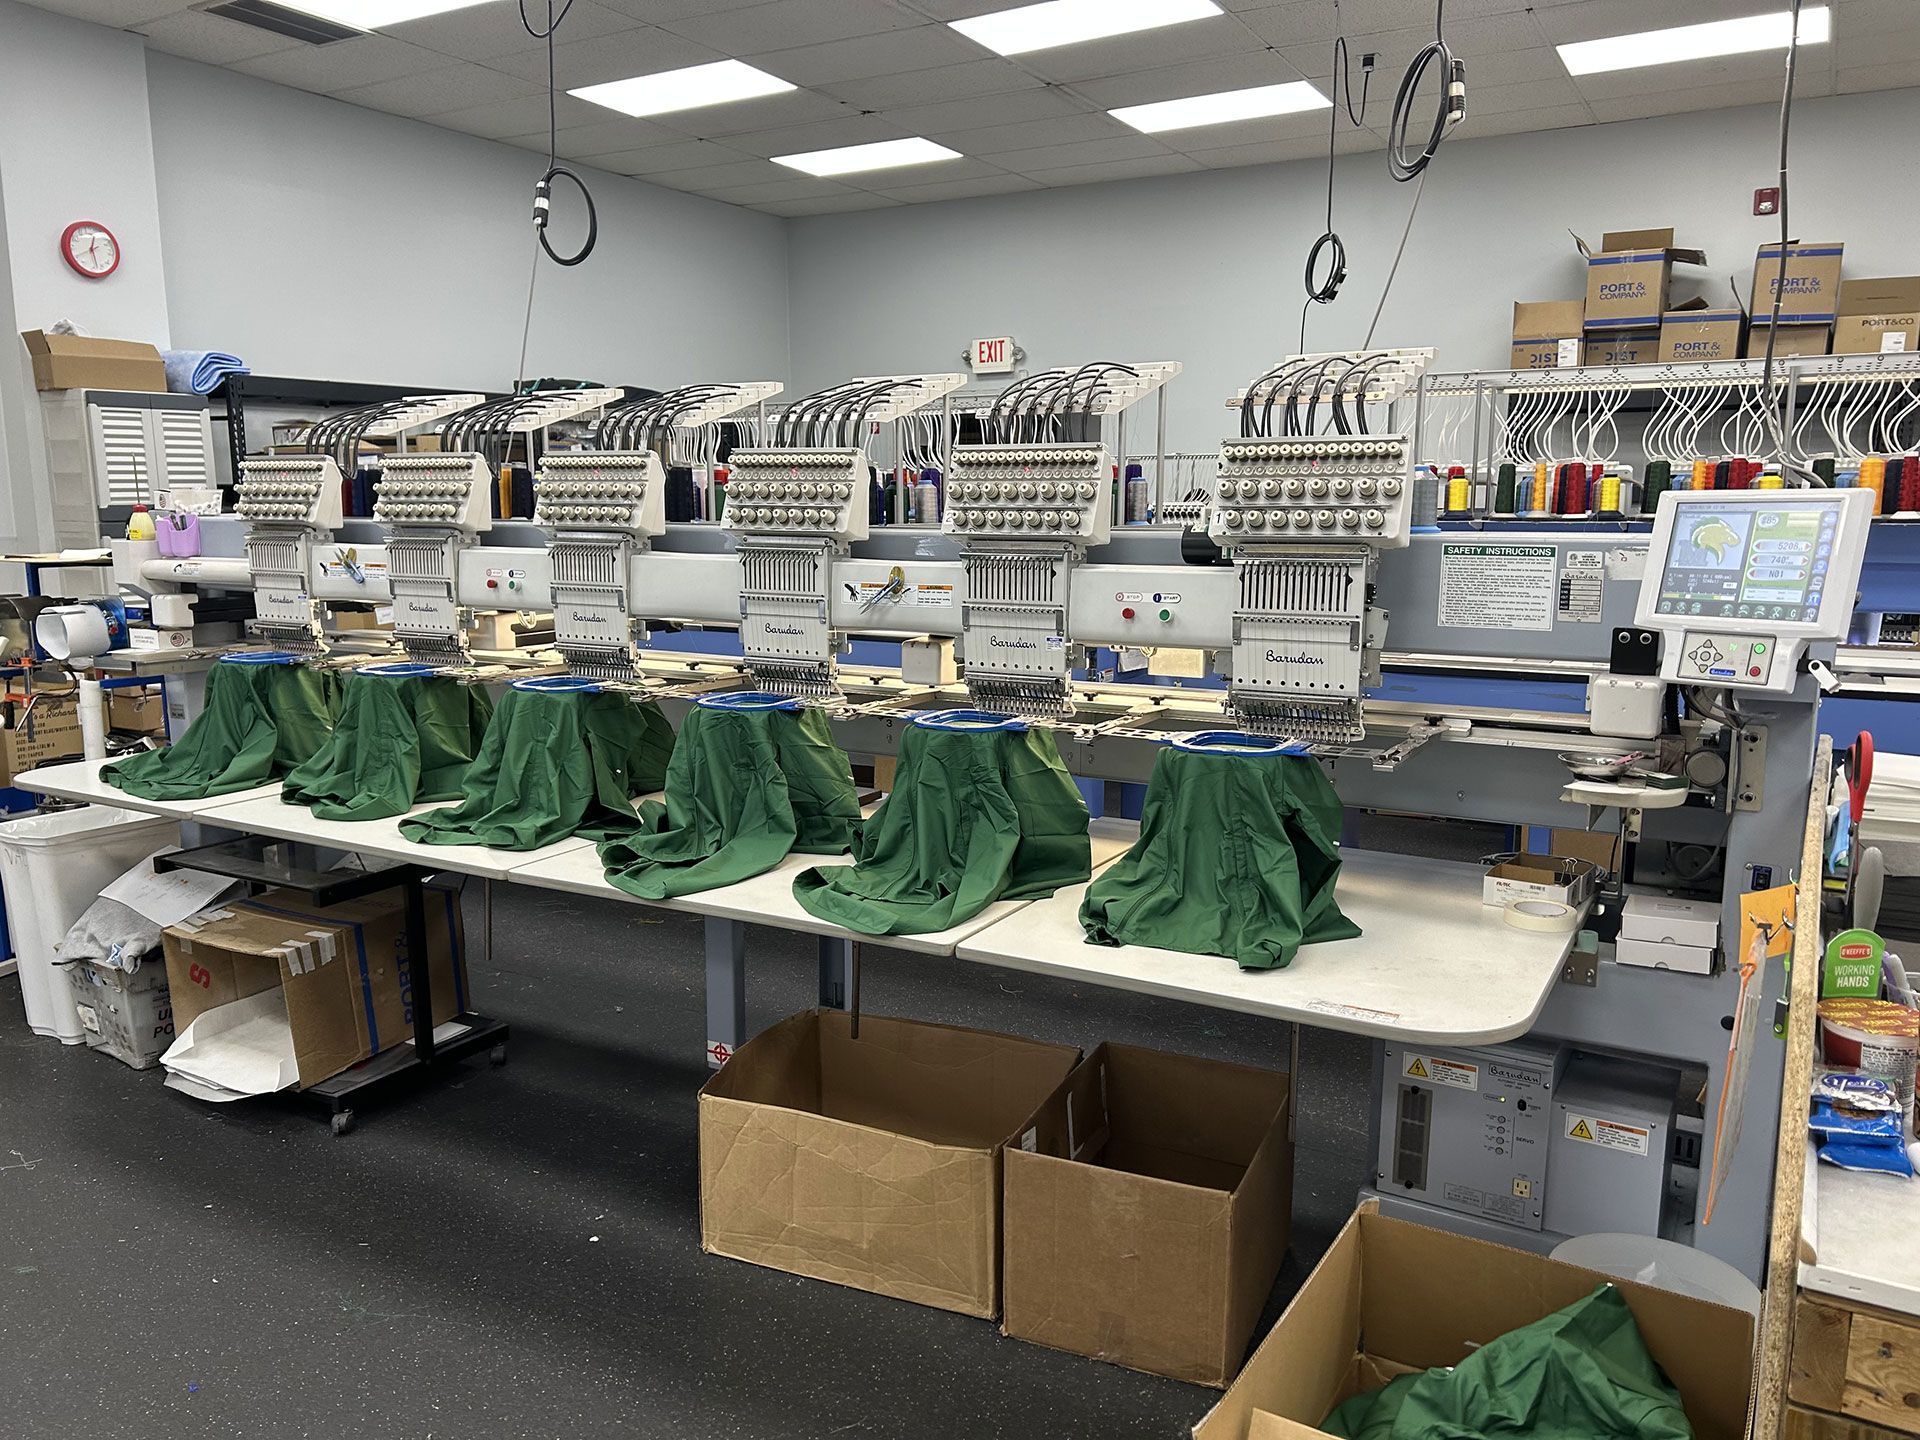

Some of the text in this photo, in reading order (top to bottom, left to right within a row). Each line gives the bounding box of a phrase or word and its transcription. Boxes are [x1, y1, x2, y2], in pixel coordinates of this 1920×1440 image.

[1810, 276, 1820, 286] &
[1600, 281, 1646, 293] PORT &
[1769, 286, 1819, 296] CMPANY
[1599, 291, 1645, 301] COMPANY
[978, 340, 1005, 363] EXIT
[1674, 341, 1721, 351] PORT &
[1673, 350, 1720, 359] COMPANY
[1447, 547, 1552, 556] SAFETY INSTRUCTIONS
[268, 595, 294, 604] Barudan
[408, 602, 438, 613] Barudan
[572, 611, 607, 623] Barudan
[765, 622, 804, 635] Barudan
[990, 635, 1036, 649] Barudan
[1265, 649, 1324, 665] Barudan
[886, 718, 893, 728] 3
[1834, 964, 1875, 976] WORKING
[1836, 976, 1870, 988] HANDS
[1490, 1065, 1538, 1083] Barudan
